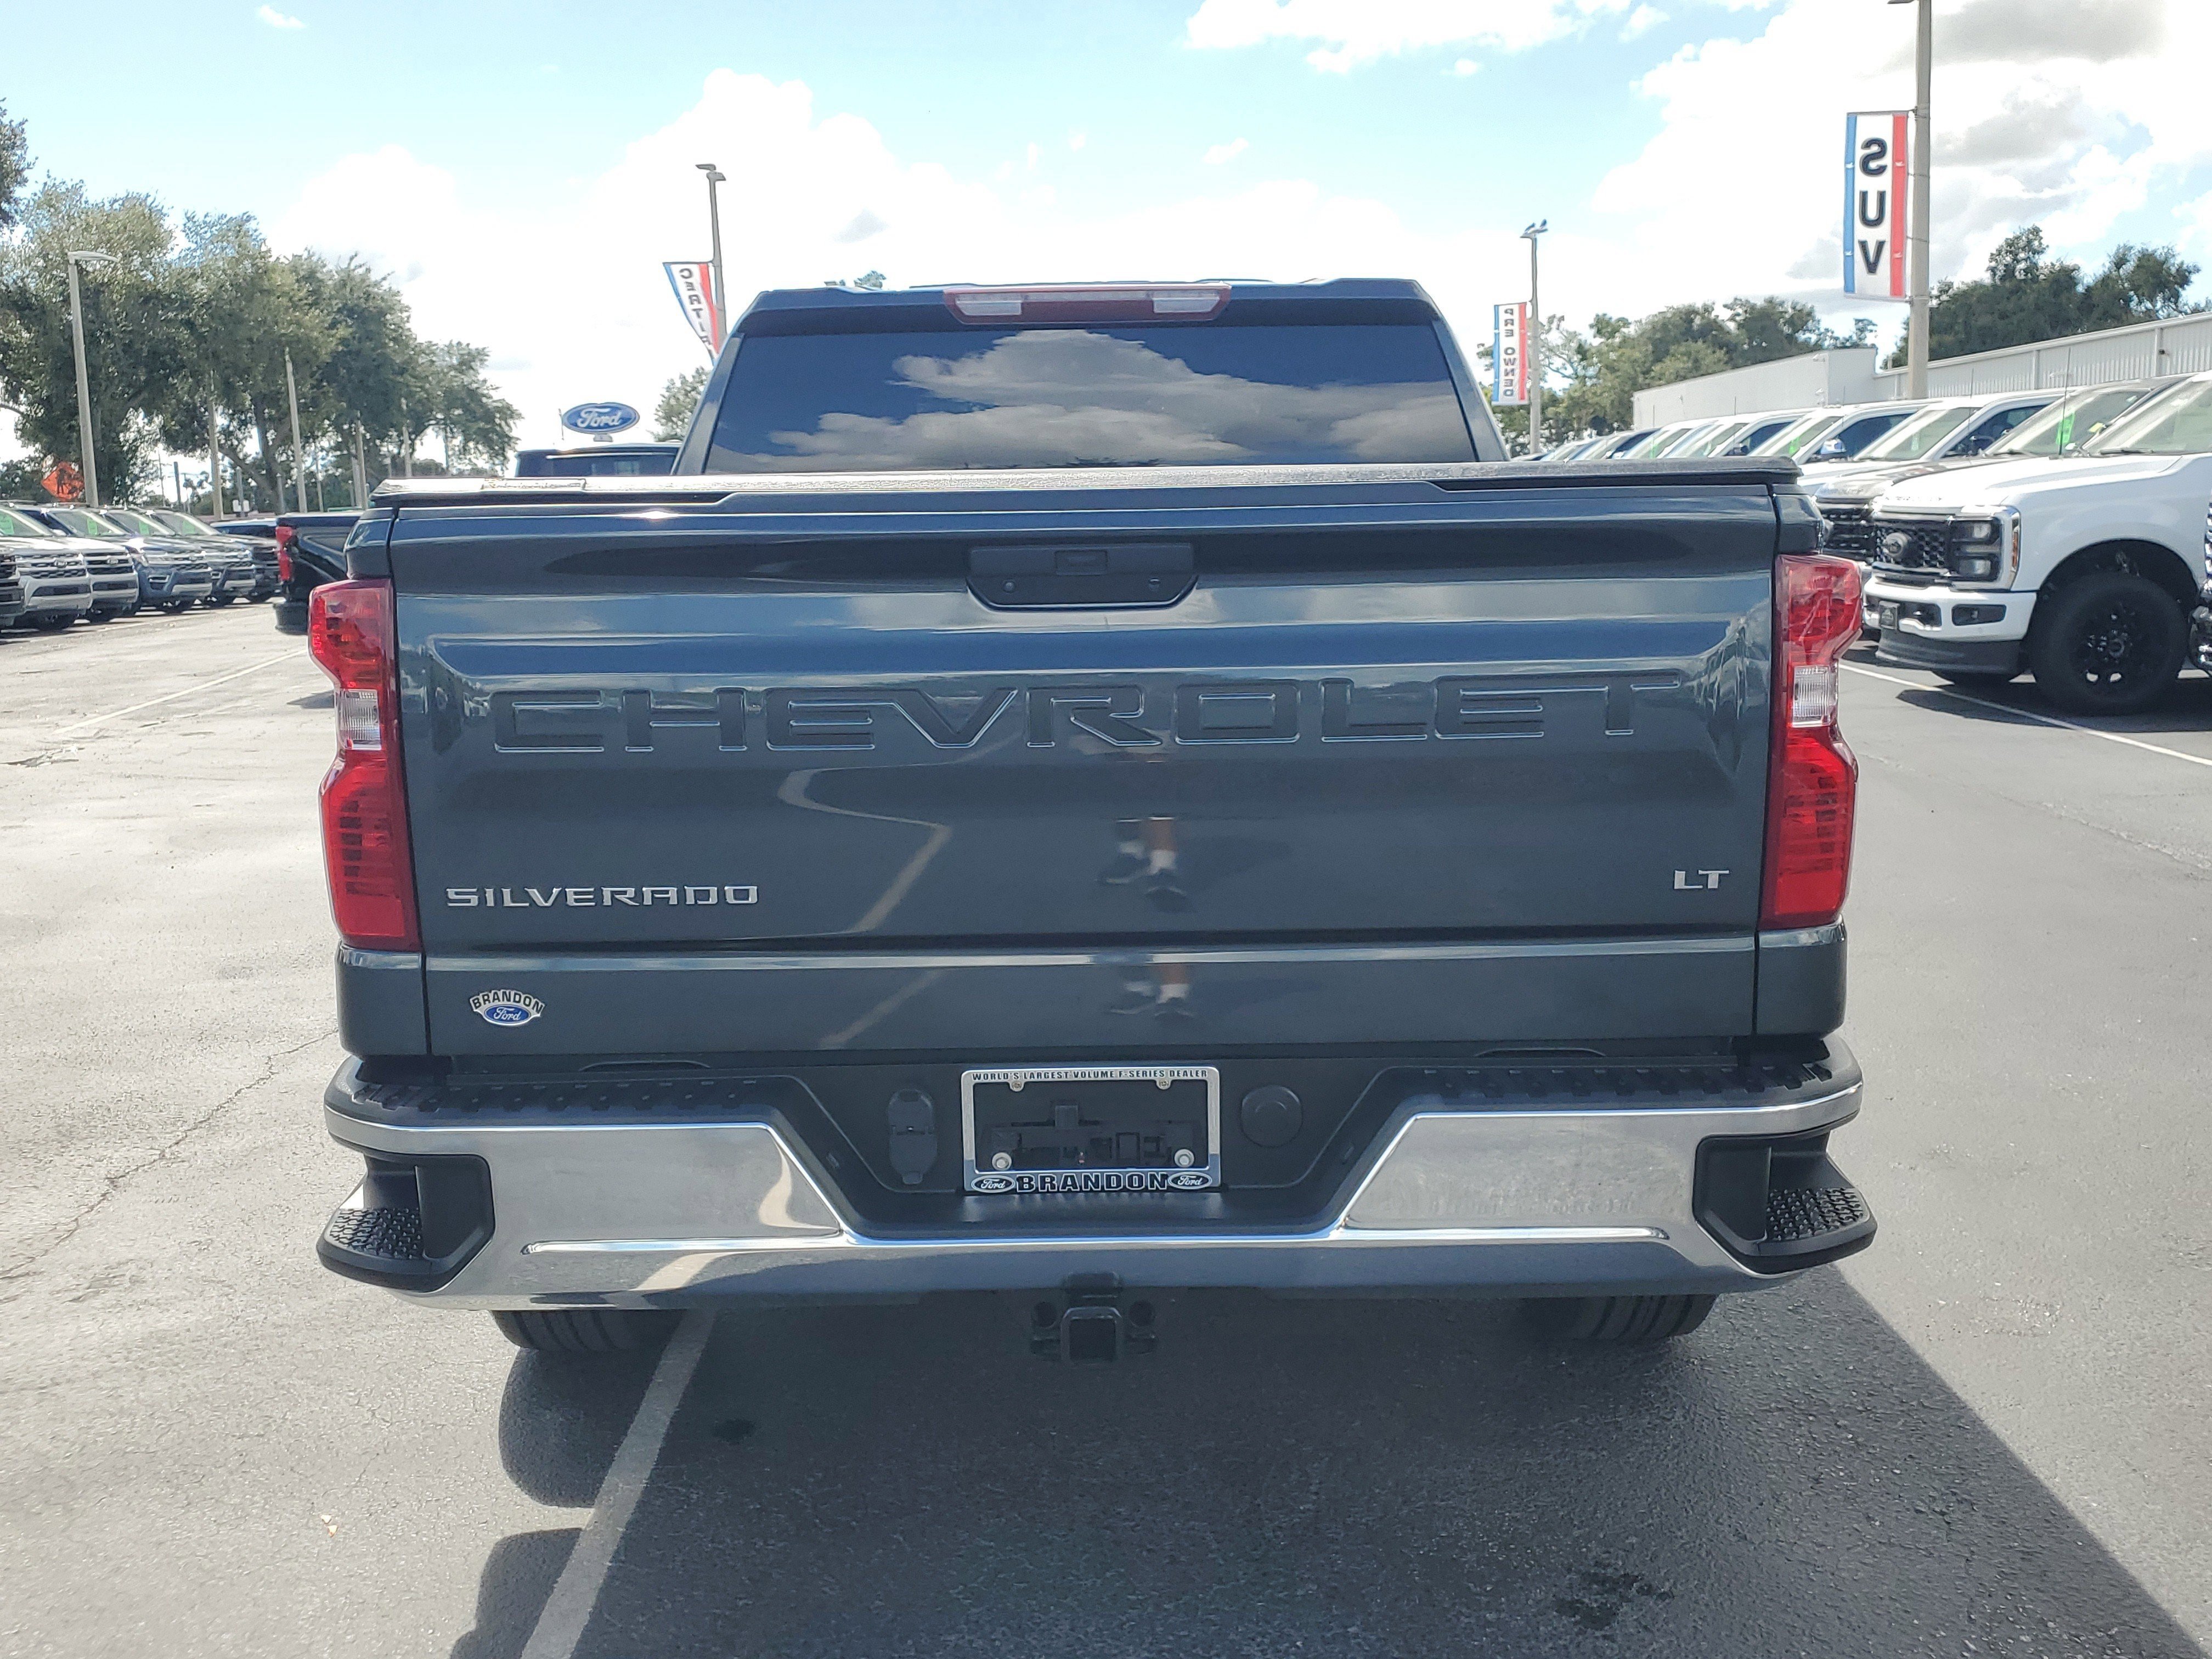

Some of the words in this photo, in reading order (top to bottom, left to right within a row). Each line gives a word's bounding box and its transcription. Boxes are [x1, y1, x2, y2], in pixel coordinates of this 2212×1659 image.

[577, 408, 622, 428] Ford
[490, 669, 1681, 753] CHEVROLET
[1674, 869, 1730, 889] LT
[445, 885, 759, 907] SILVERADO
[471, 990, 544, 1015] BRANDON
[494, 1007, 522, 1021] Ford
[972, 1072, 1020, 1081] WORLD'S
[1023, 1071, 1069, 1080] LARGEST
[1073, 1070, 1115, 1079] VOLUME
[1118, 1069, 1165, 1078] F-SERIES
[1169, 1069, 1207, 1077] DEALER
[980, 1178, 1006, 1189] Ford
[1016, 1172, 1169, 1193] BRANDON
[1177, 1175, 1203, 1186] Ford
